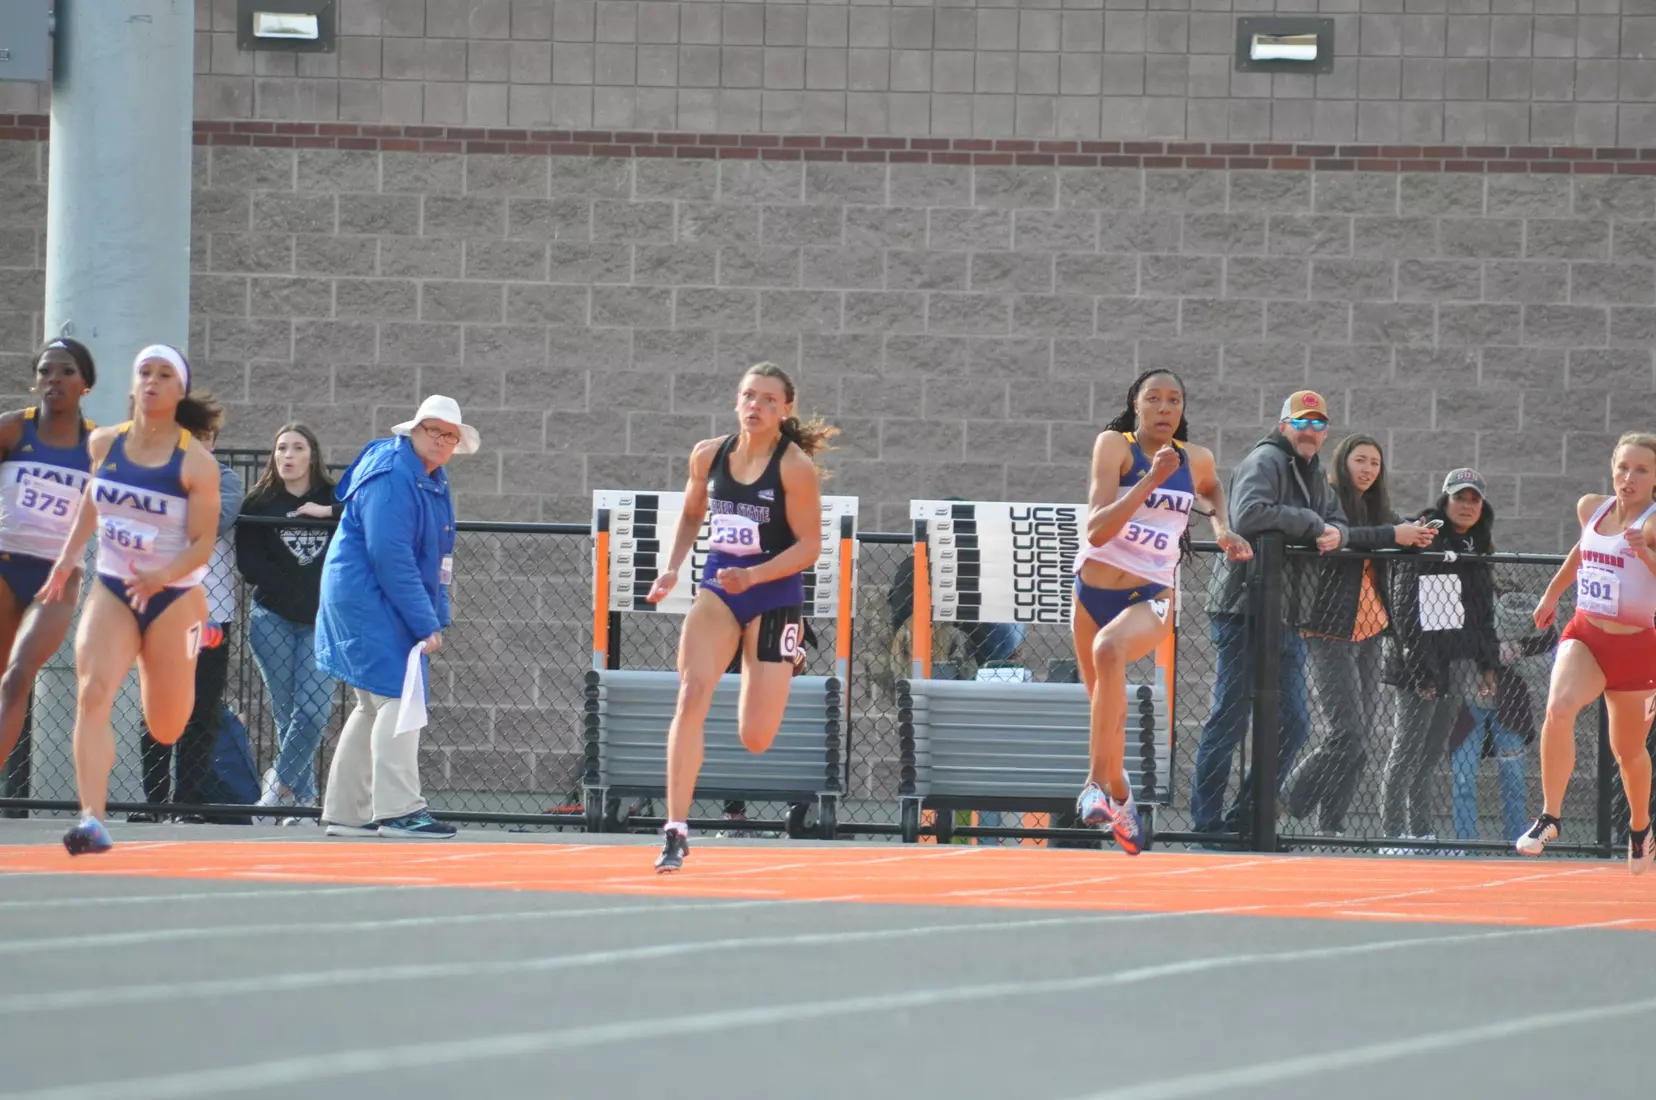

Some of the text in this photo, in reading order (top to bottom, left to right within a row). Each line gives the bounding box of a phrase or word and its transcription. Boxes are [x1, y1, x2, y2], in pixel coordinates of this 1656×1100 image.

[22, 487, 70, 516] 375
[96, 485, 167, 515] NAU
[736, 502, 770, 523] STATE
[1010, 506, 1076, 521] UCS
[105, 521, 146, 551] 361
[713, 527, 753, 545] 538
[1012, 521, 1078, 536] UCS
[1125, 524, 1168, 550] 376
[1013, 535, 1079, 550] UCS
[1013, 550, 1078, 564] UCS
[1581, 578, 1612, 600] 501
[190, 625, 199, 655] 7
[785, 627, 796, 652] 6
